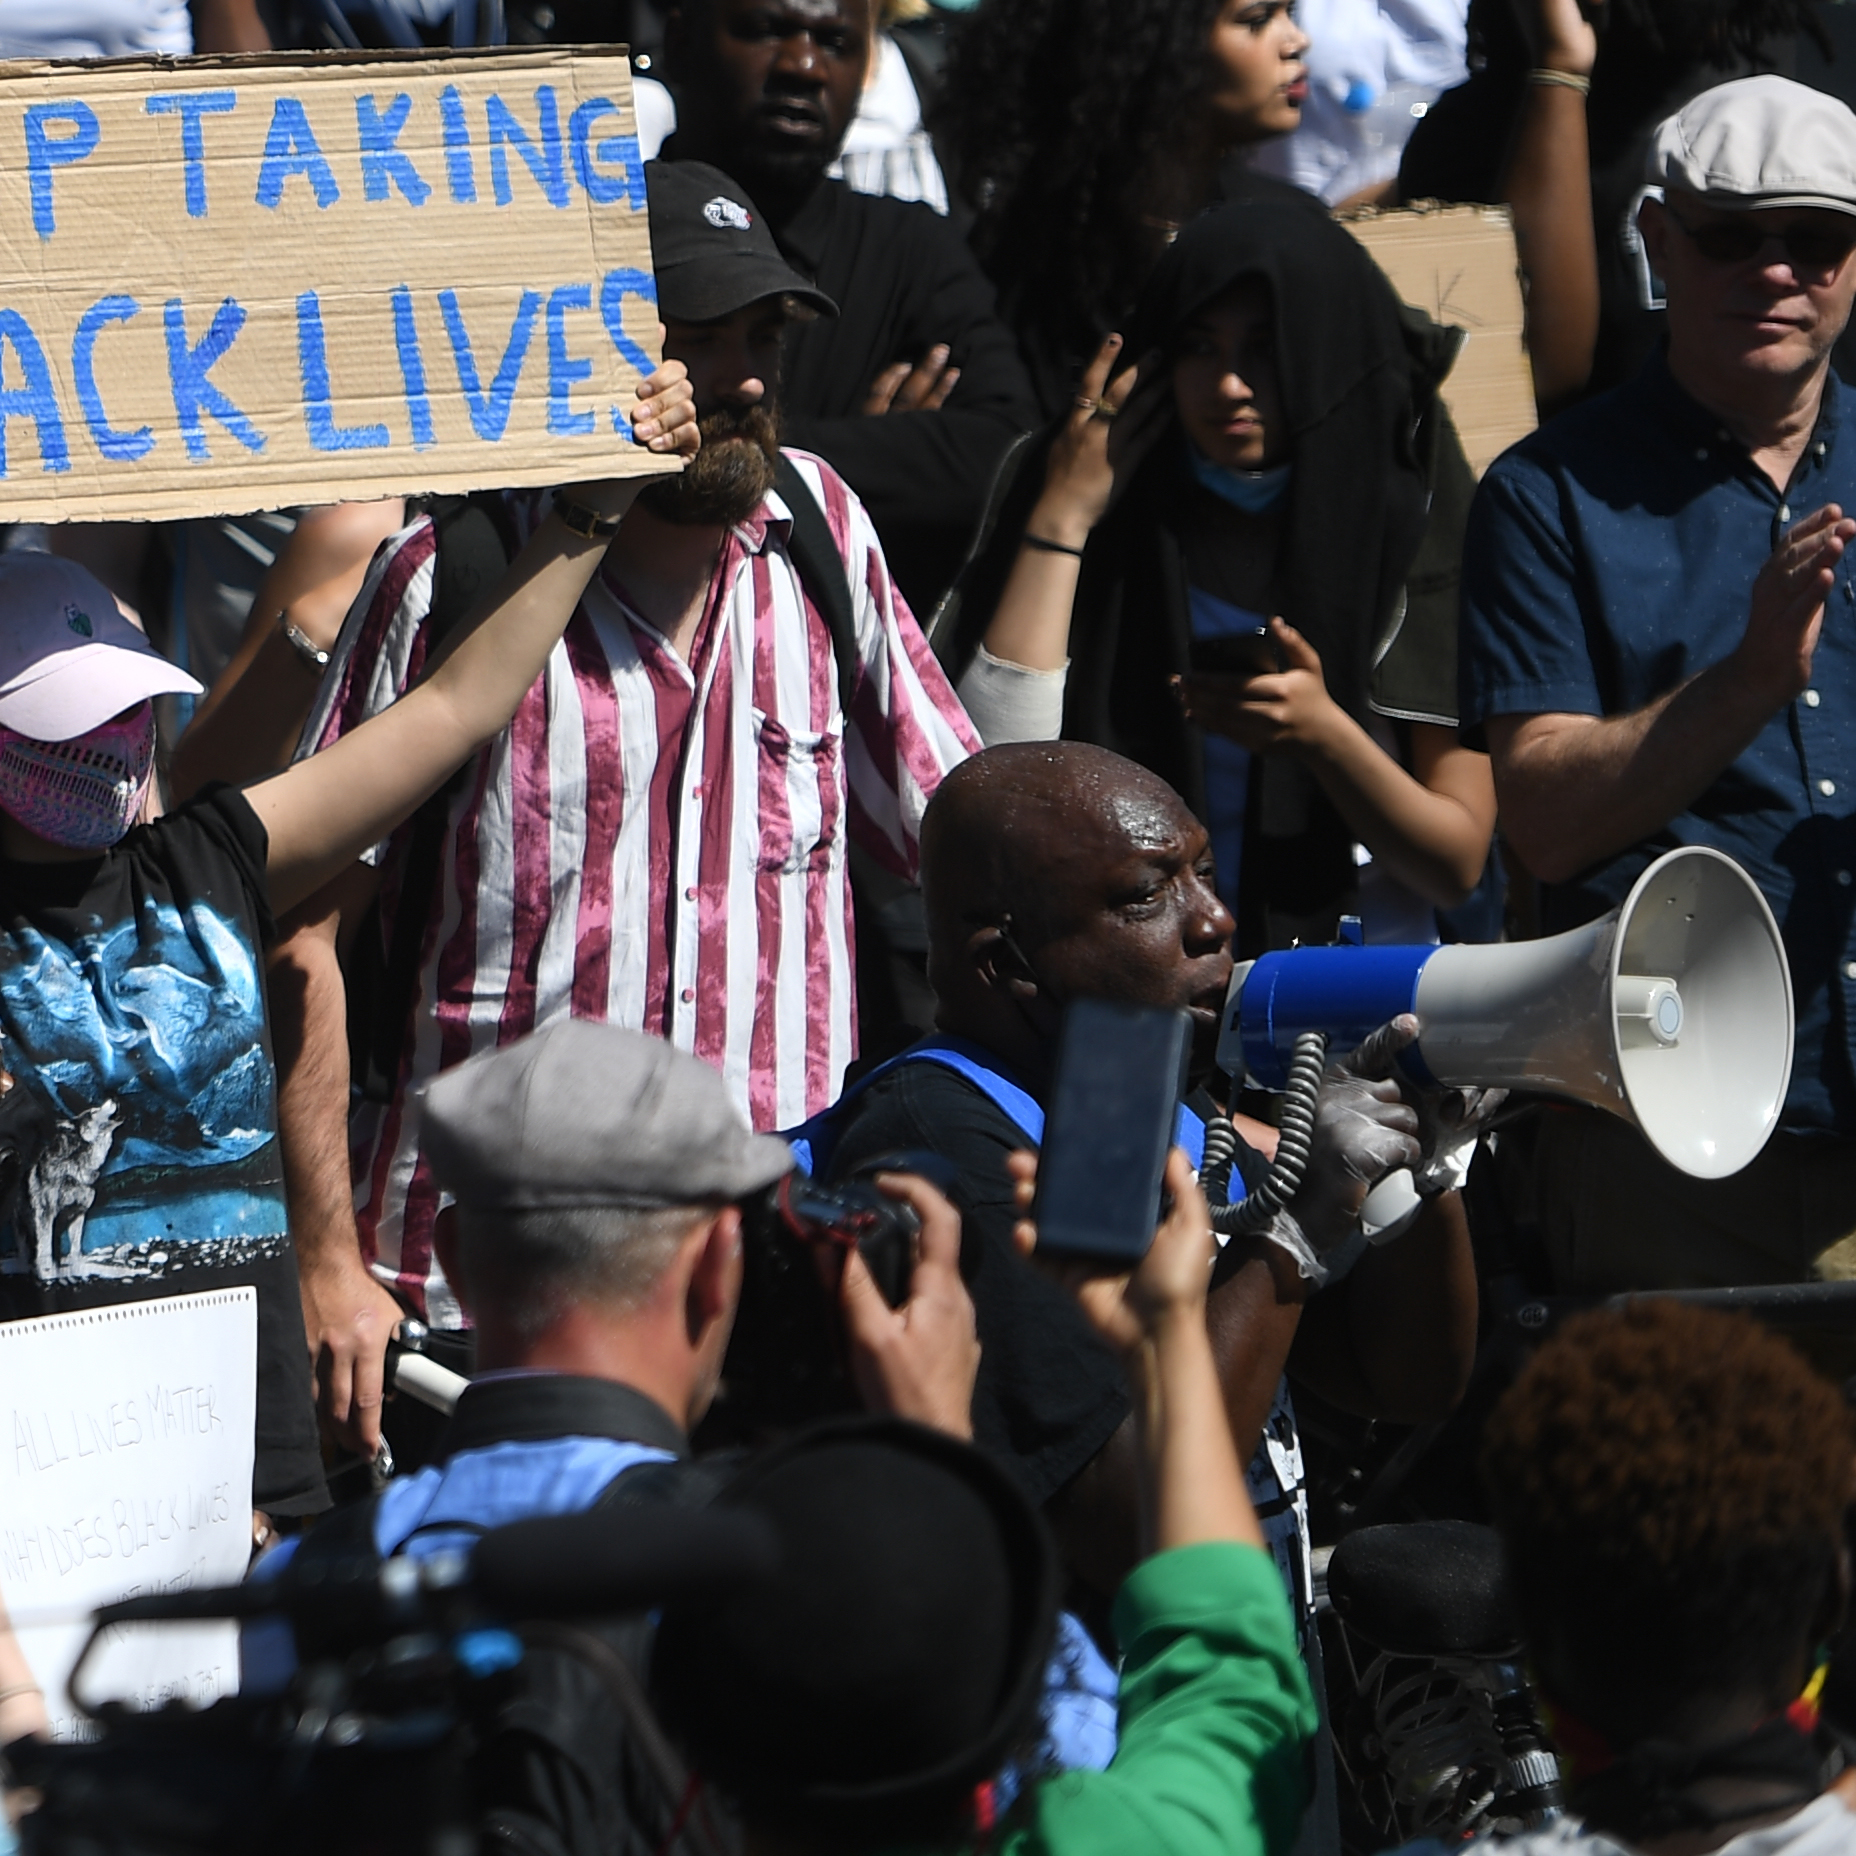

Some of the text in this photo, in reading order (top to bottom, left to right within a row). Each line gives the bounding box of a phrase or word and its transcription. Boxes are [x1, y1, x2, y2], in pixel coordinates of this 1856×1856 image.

[146, 83, 648, 219] TAKING
[297, 266, 662, 451] LIVES
[12, 1383, 224, 1476] ALL LIVES MATTER
[47, 1516, 113, 1577] DOES
[113, 1495, 182, 1558] BLACK
[187, 1481, 231, 1532] LIVES
